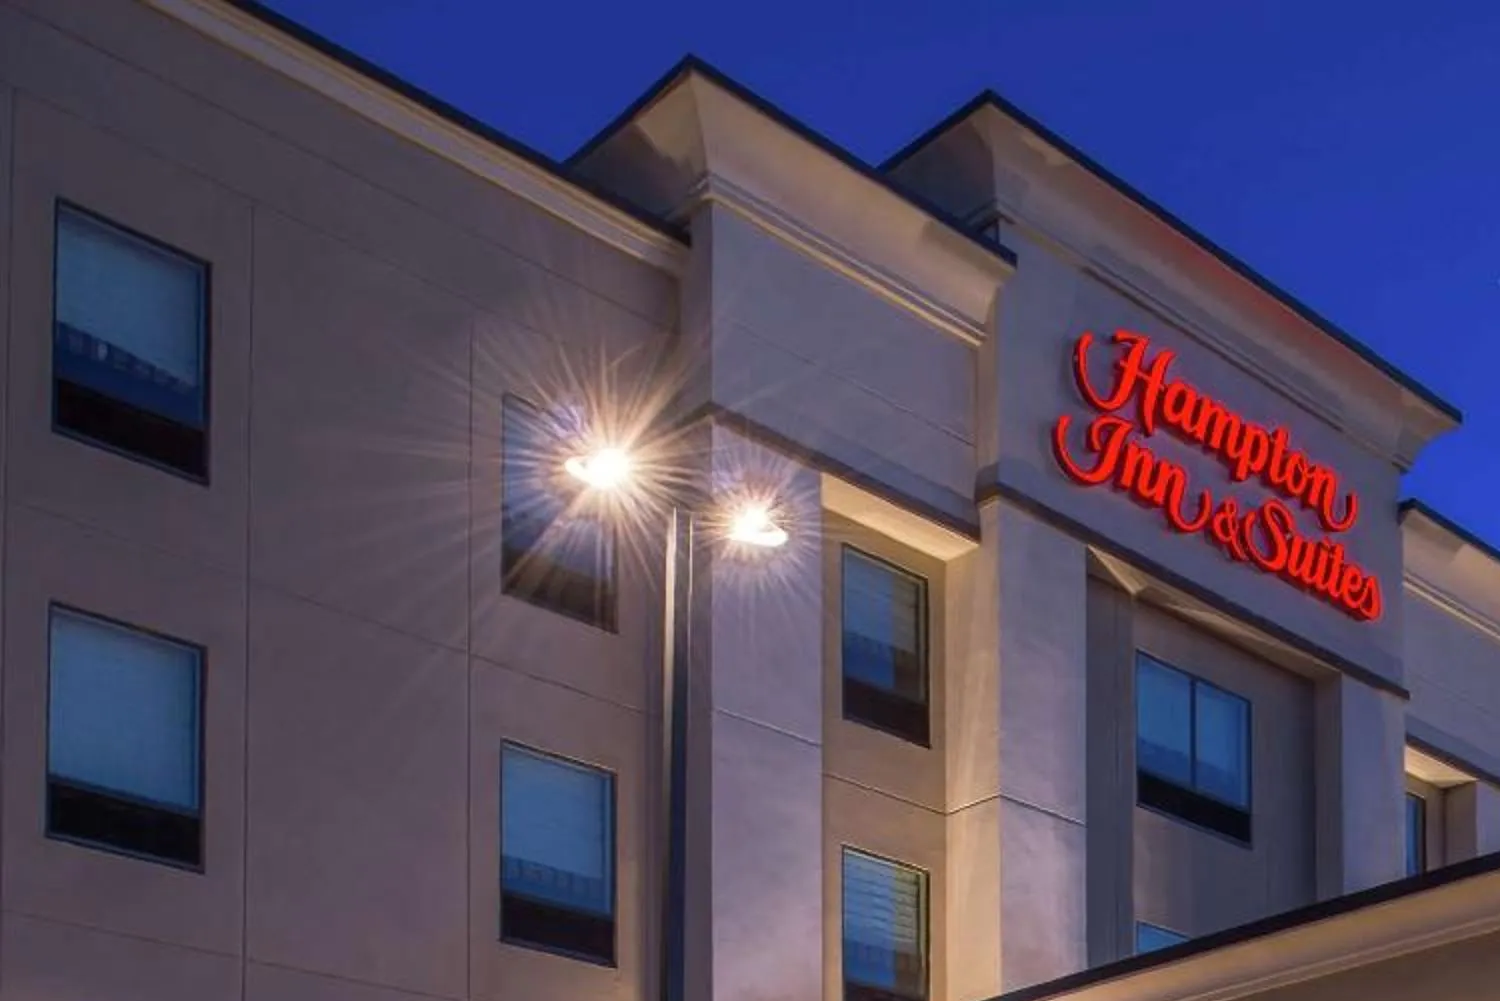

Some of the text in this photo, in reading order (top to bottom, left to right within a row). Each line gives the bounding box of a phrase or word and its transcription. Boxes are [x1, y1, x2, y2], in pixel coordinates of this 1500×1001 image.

[1054, 413, 1384, 621] Inn & Suites
[1073, 329, 1359, 532] Hampton
